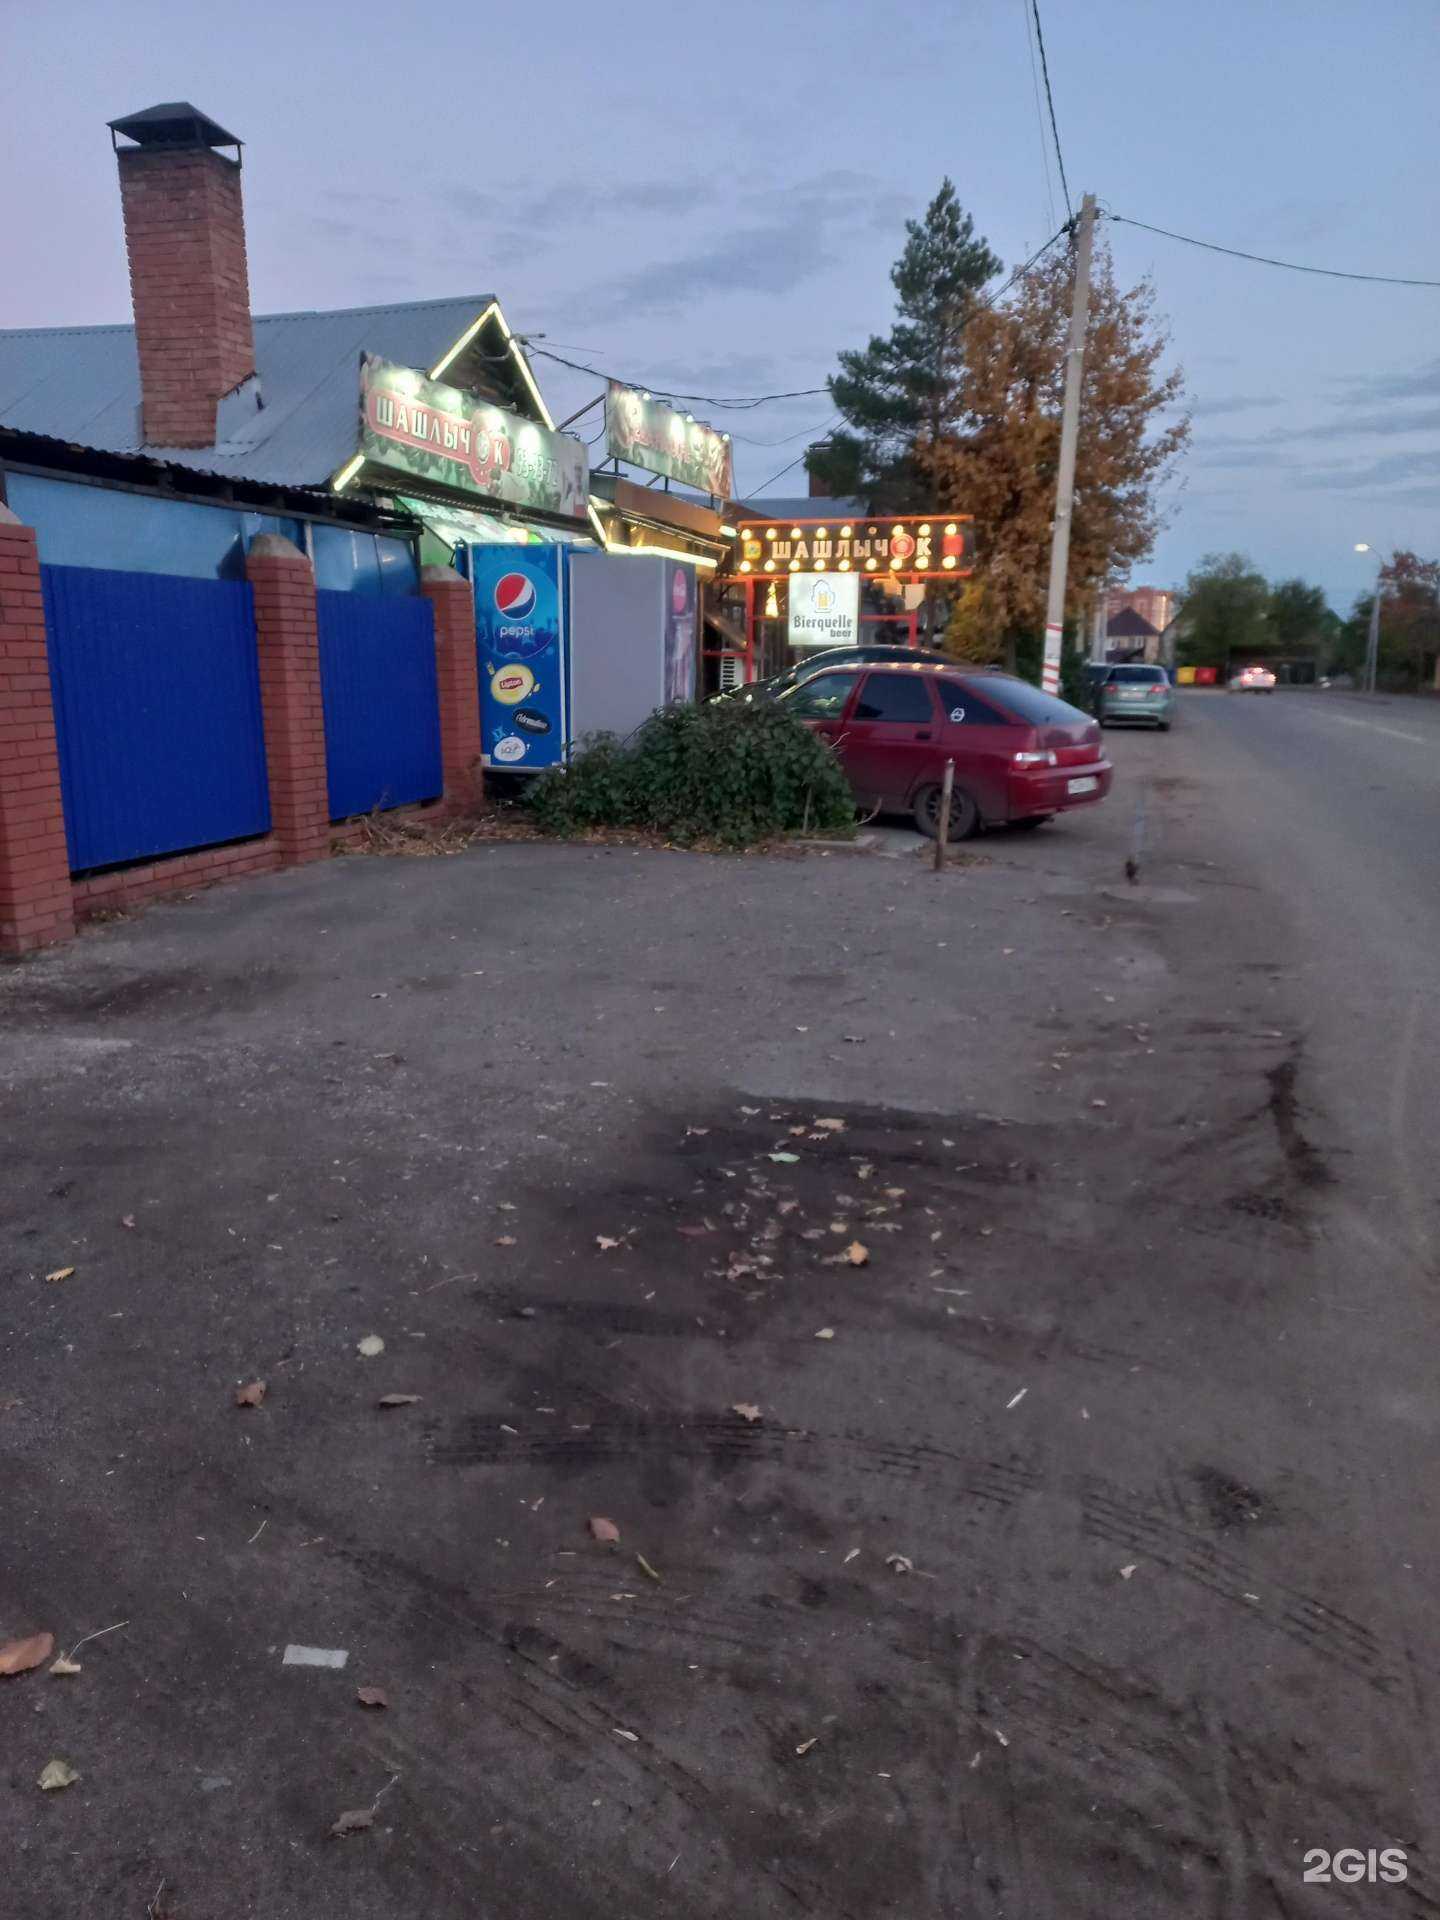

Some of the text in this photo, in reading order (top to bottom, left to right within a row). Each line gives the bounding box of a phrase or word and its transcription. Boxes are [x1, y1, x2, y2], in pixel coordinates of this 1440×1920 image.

[771, 533, 932, 560] ШАШЛЫЧОК
[794, 615, 852, 631] Bierquelle
[500, 625, 534, 638] pepsi
[830, 630, 852, 638] beer
